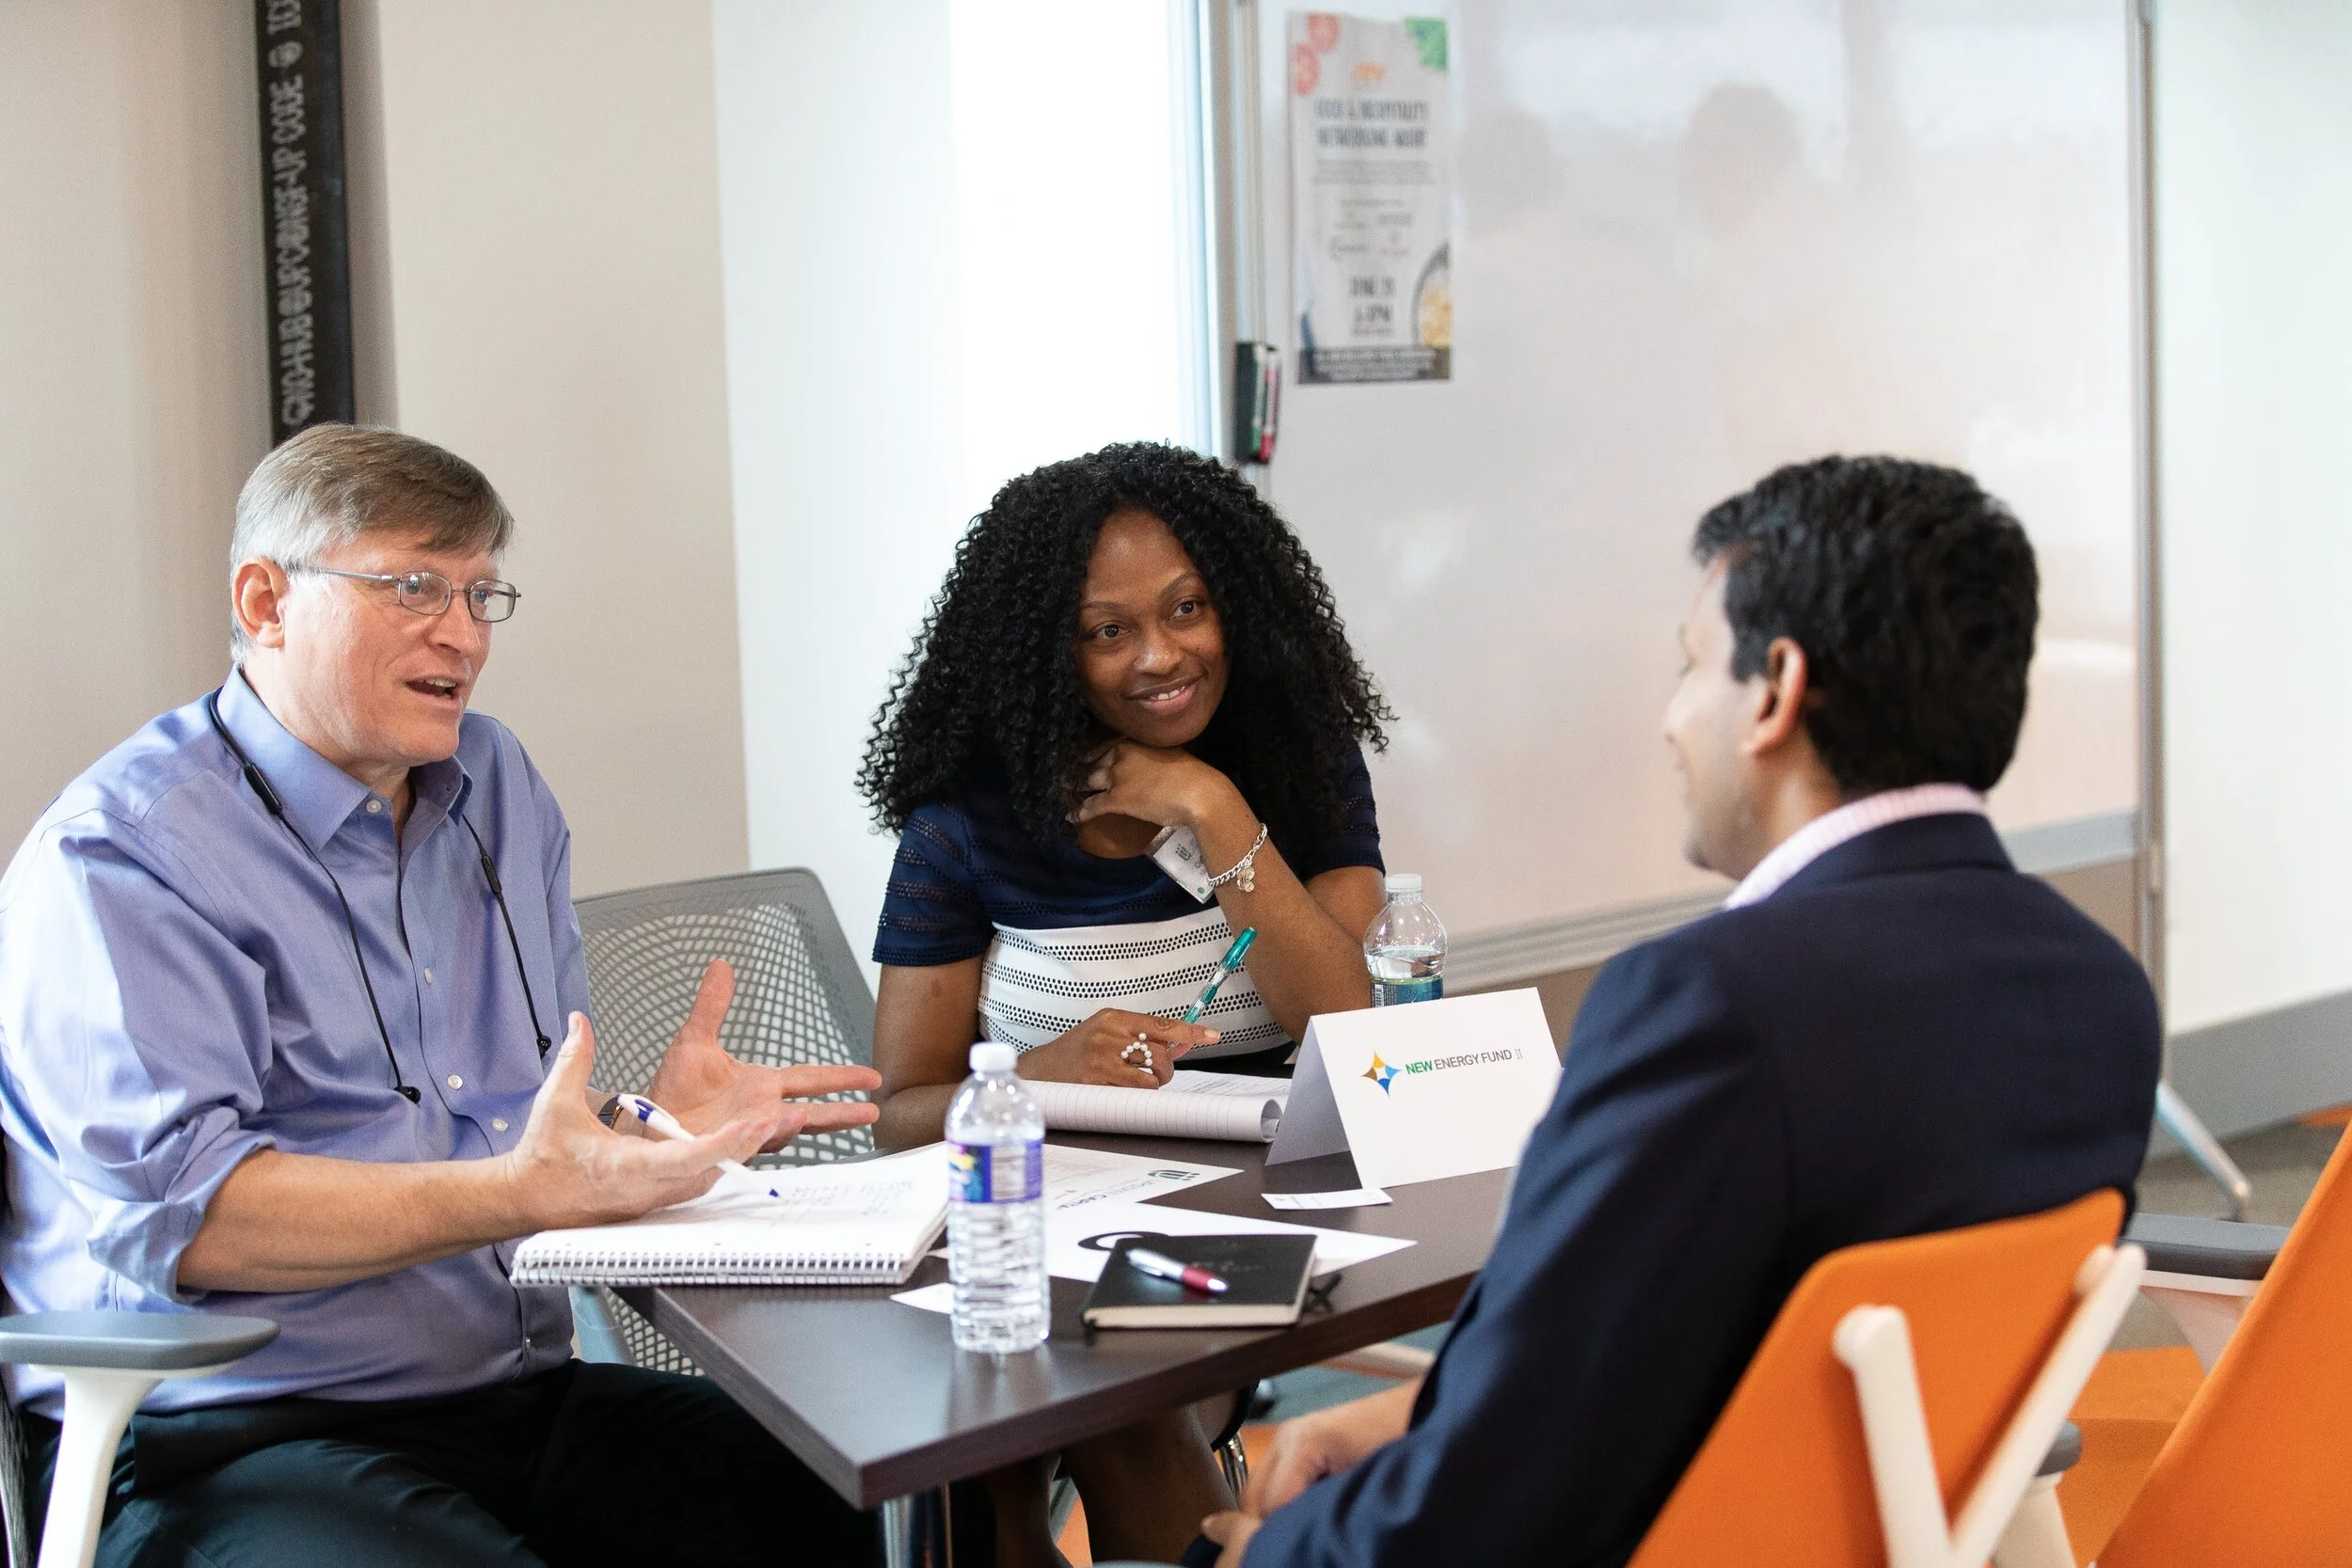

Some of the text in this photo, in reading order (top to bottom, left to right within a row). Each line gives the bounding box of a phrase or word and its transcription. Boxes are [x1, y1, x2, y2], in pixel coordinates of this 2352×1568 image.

[270, 74, 306, 144] CODE
[1406, 1060, 1433, 1074] NEW
[1434, 1053, 1480, 1070] ENERGY
[1481, 1049, 1513, 1064] FUND
